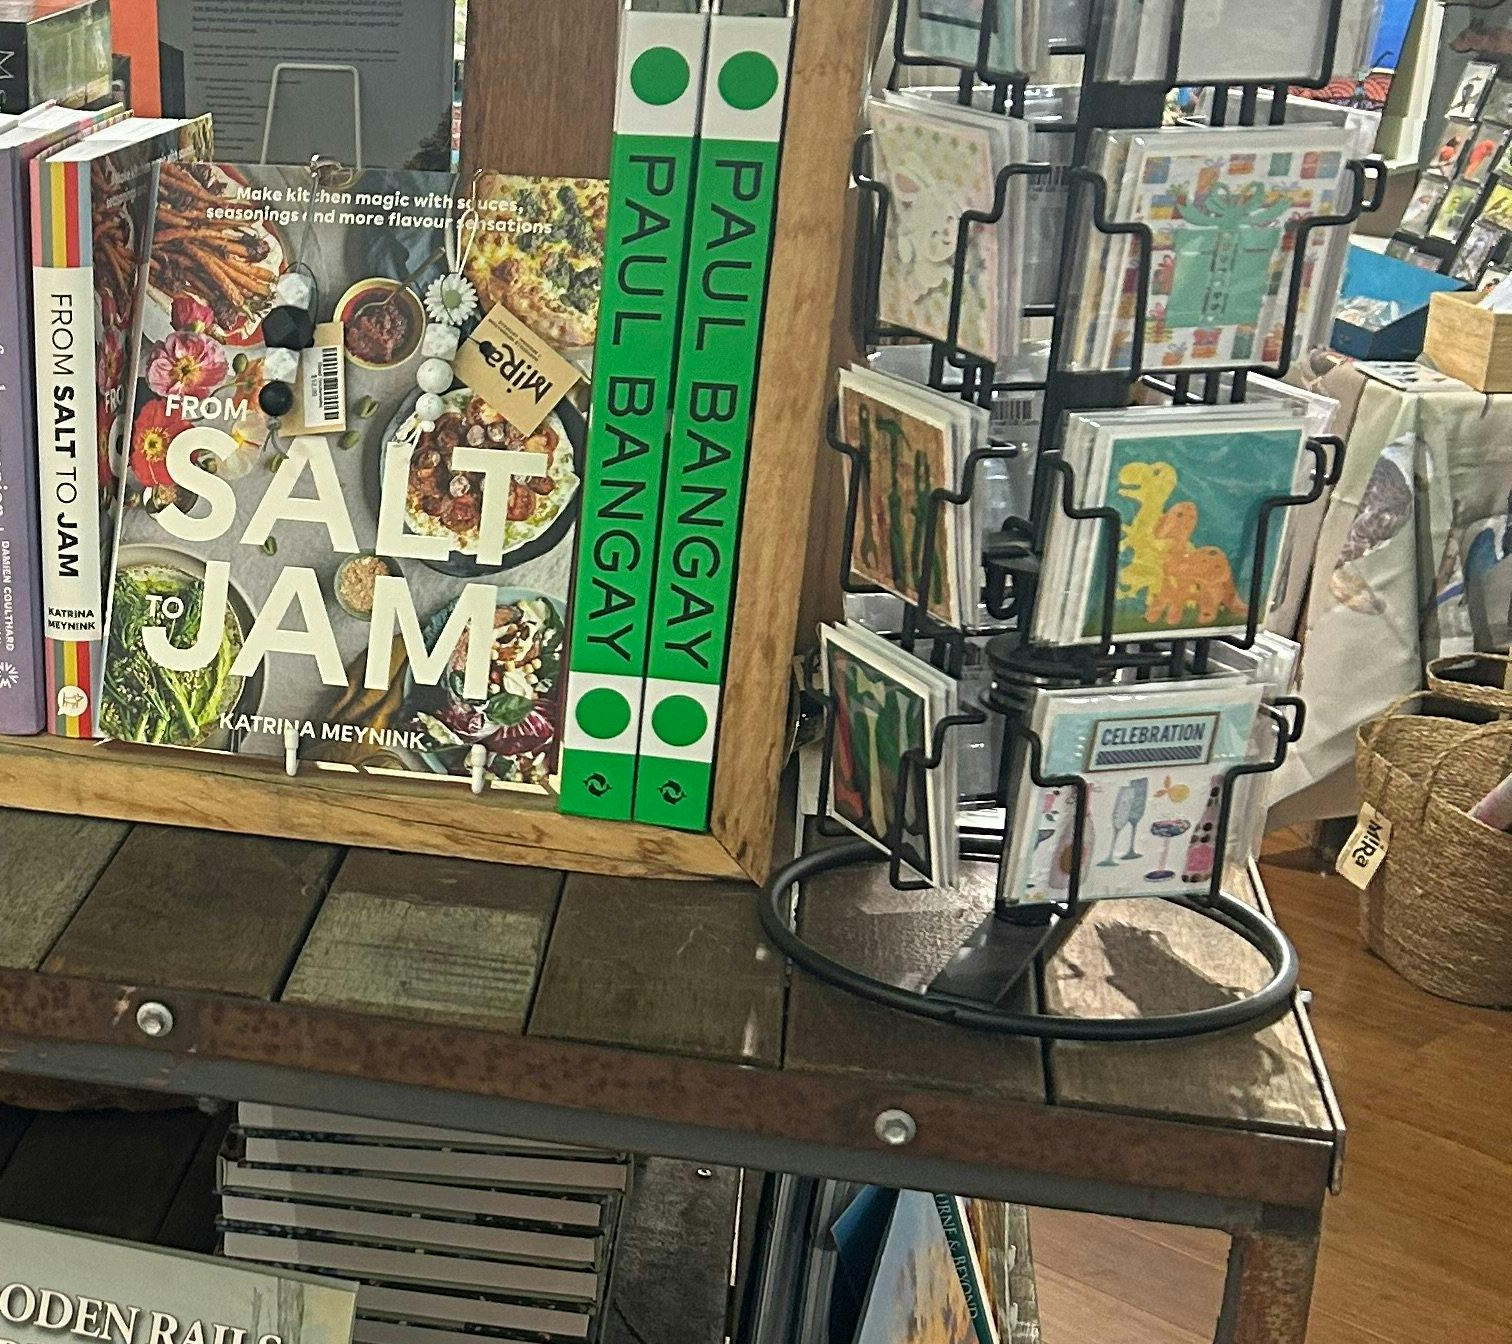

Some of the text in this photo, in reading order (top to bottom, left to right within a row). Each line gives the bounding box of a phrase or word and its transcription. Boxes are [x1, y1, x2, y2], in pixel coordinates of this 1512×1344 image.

[237, 187, 283, 202] Make
[355, 191, 409, 210] magic
[414, 192, 454, 209] with
[206, 206, 299, 225] seasonings
[339, 215, 384, 226] more
[388, 213, 453, 229] flavour
[165, 395, 248, 420] FROM
[587, 155, 676, 662] PAUL BANGAY
[51, 293, 80, 577] FROM SALT TO JAM
[154, 427, 549, 566] SALT
[145, 595, 184, 620] TO
[142, 560, 498, 700] JAM
[219, 714, 426, 749] KATRINA MEYNINK
[1101, 723, 1206, 746] CELEBRATION
